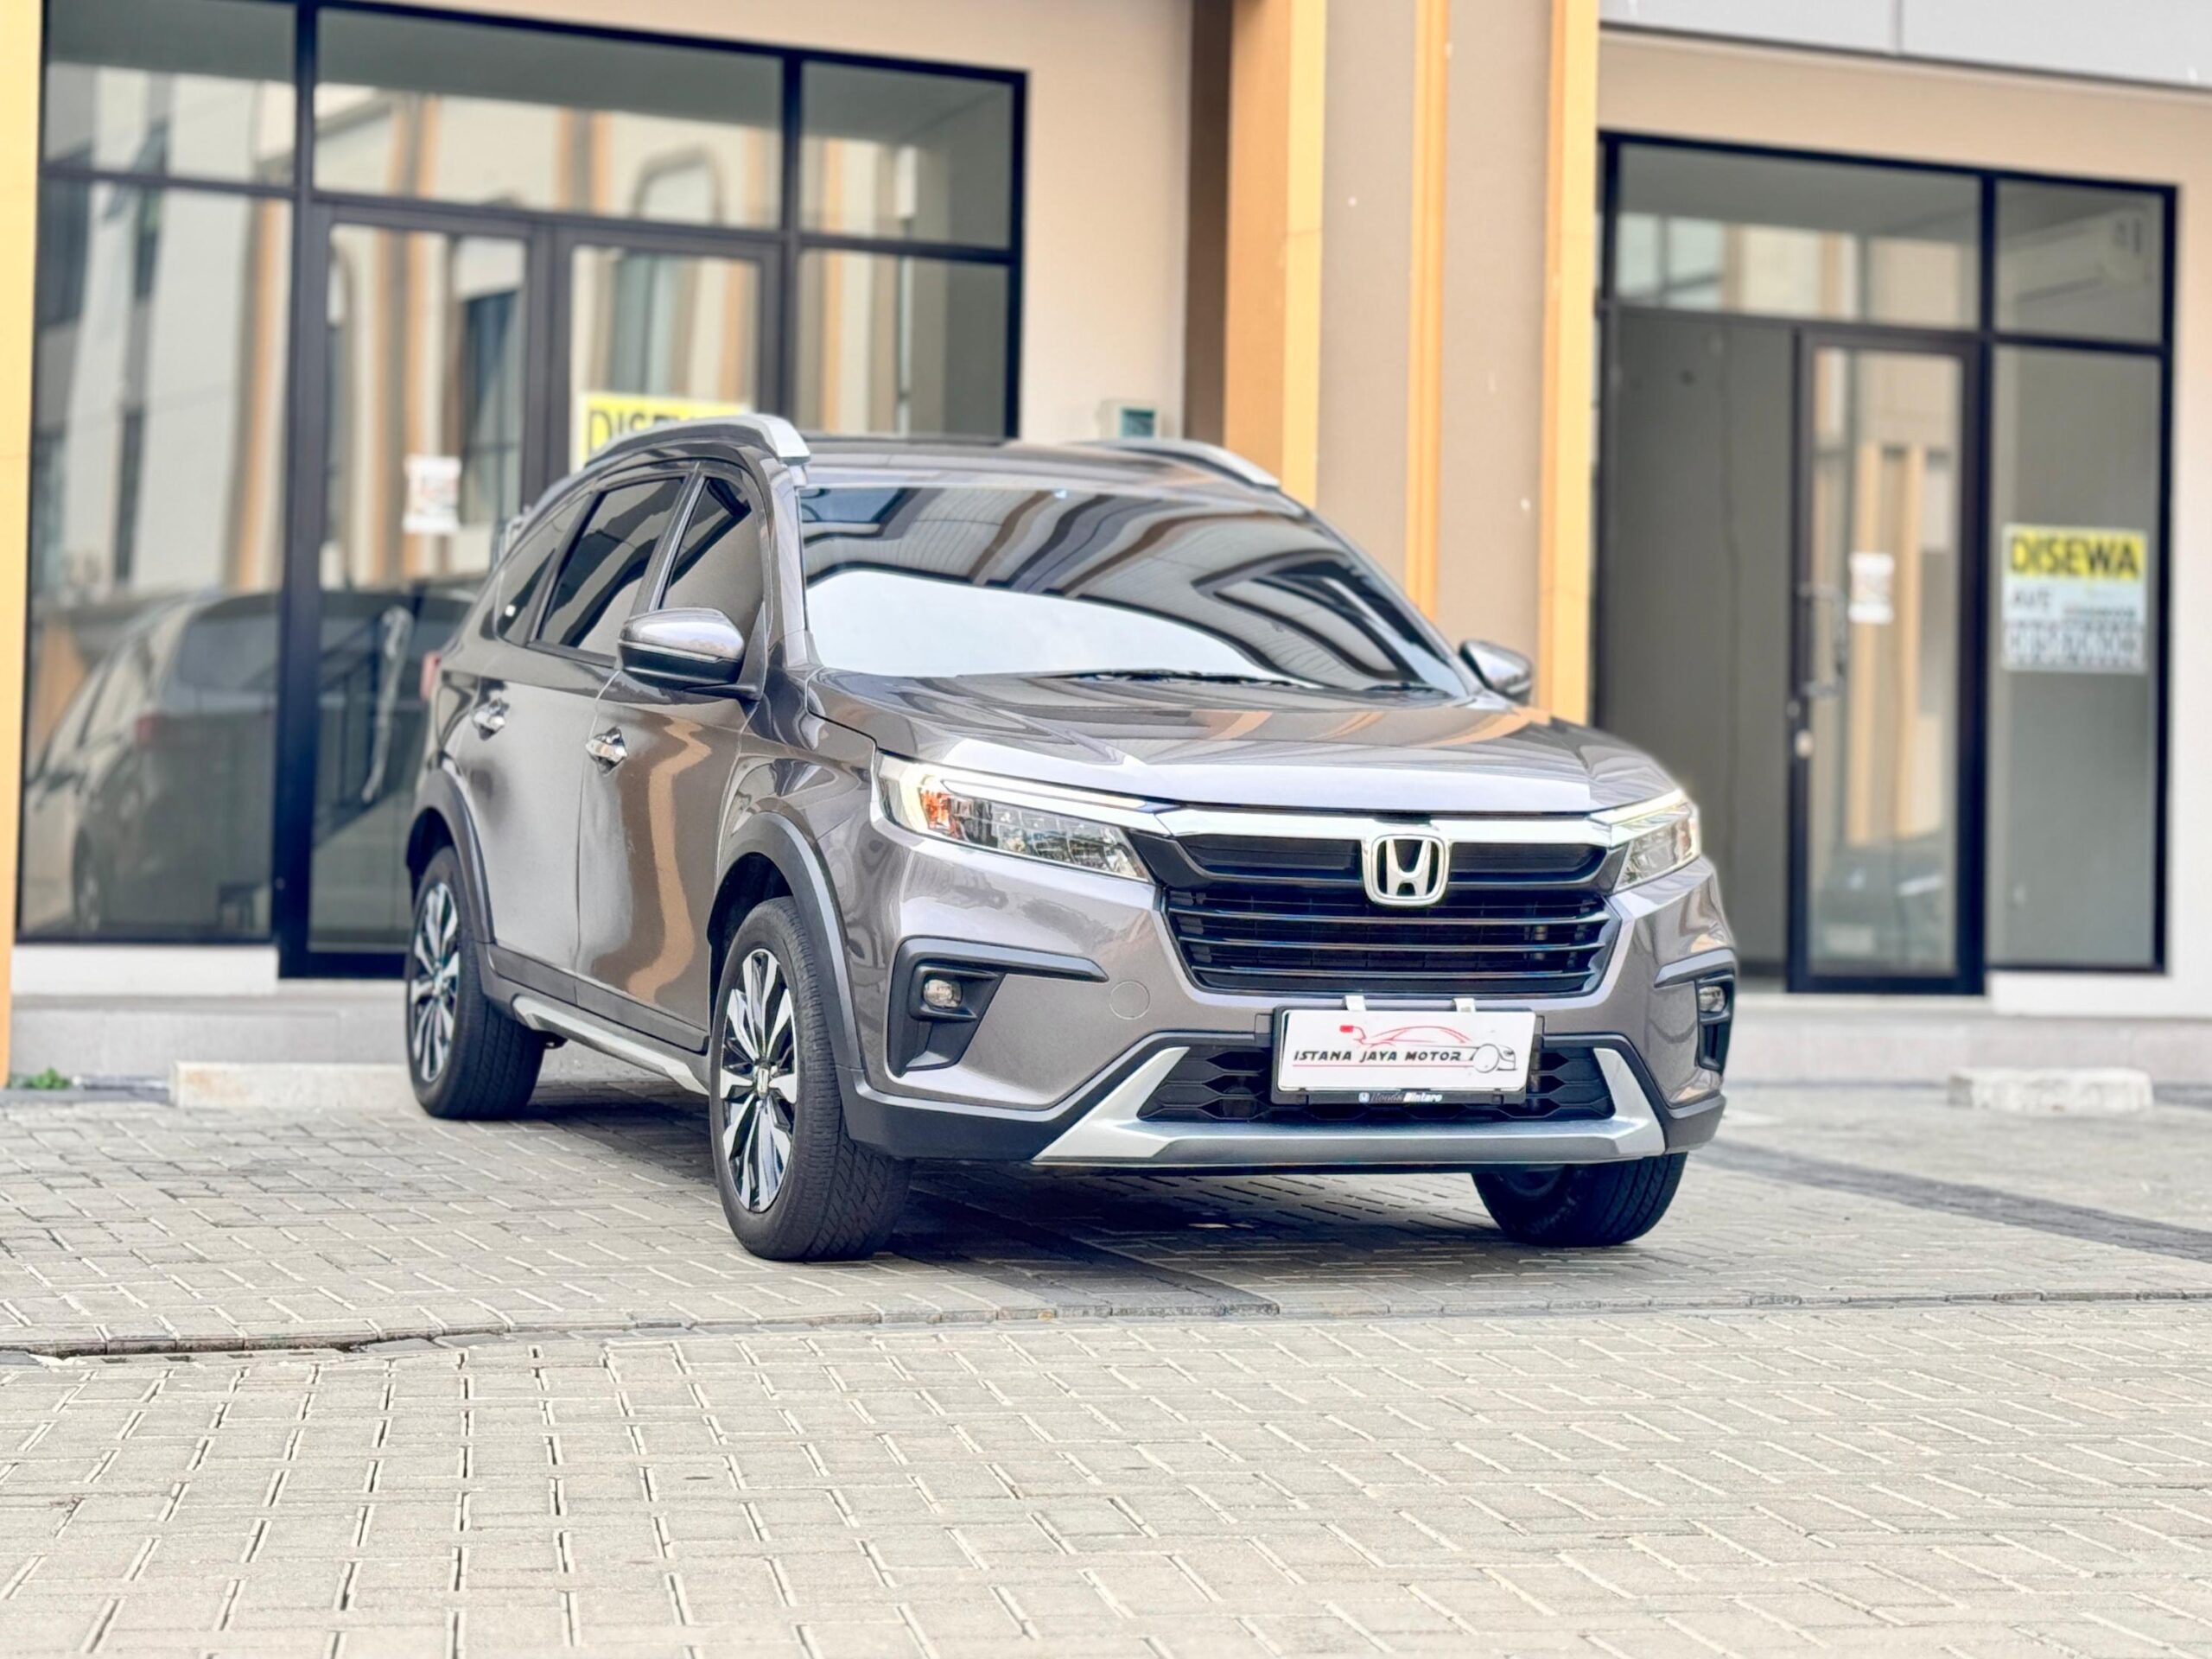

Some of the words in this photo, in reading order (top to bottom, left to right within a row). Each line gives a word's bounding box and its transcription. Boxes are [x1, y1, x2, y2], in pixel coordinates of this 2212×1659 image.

[2011, 536, 2139, 577] DISEWA
[1294, 1051, 1352, 1061] ISTANA
[1359, 1051, 1397, 1063] JAYA
[1404, 1051, 1461, 1061] MOTOR
